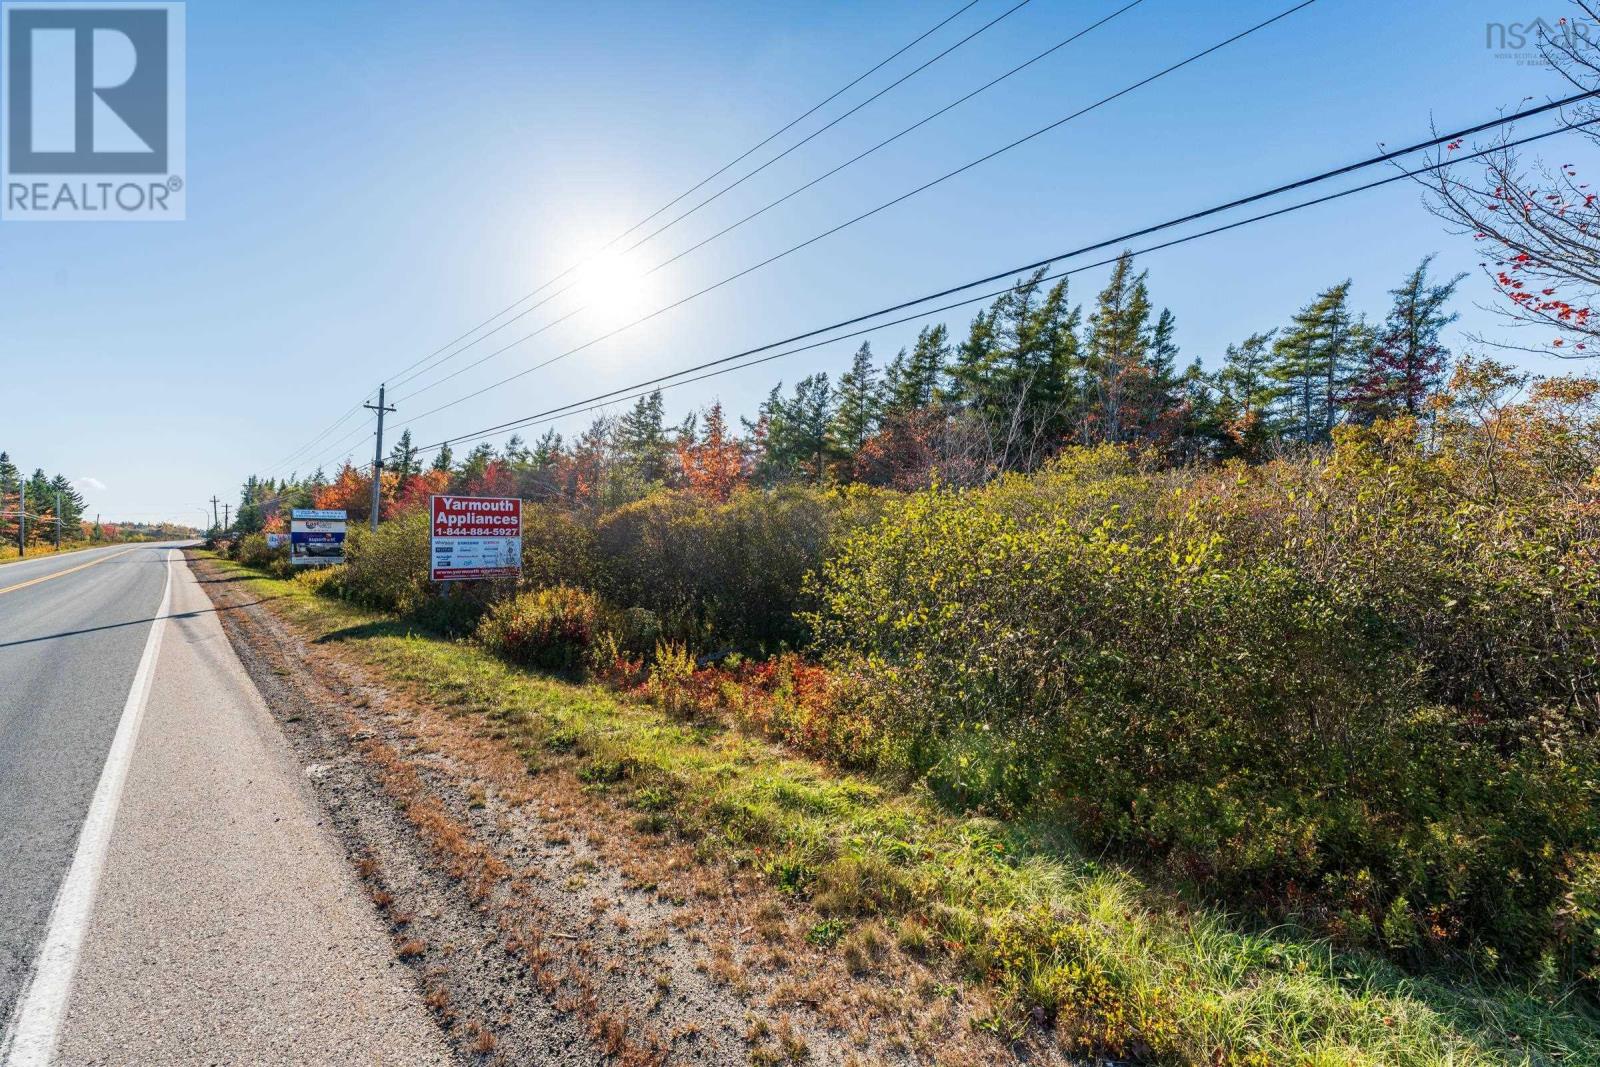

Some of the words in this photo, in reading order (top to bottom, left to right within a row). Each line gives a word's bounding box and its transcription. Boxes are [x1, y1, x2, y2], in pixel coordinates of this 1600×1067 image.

[442, 497, 514, 512] Yarmouth
[436, 511, 518, 526] Appliances
[436, 527, 518, 536] 1-844-884-5927
